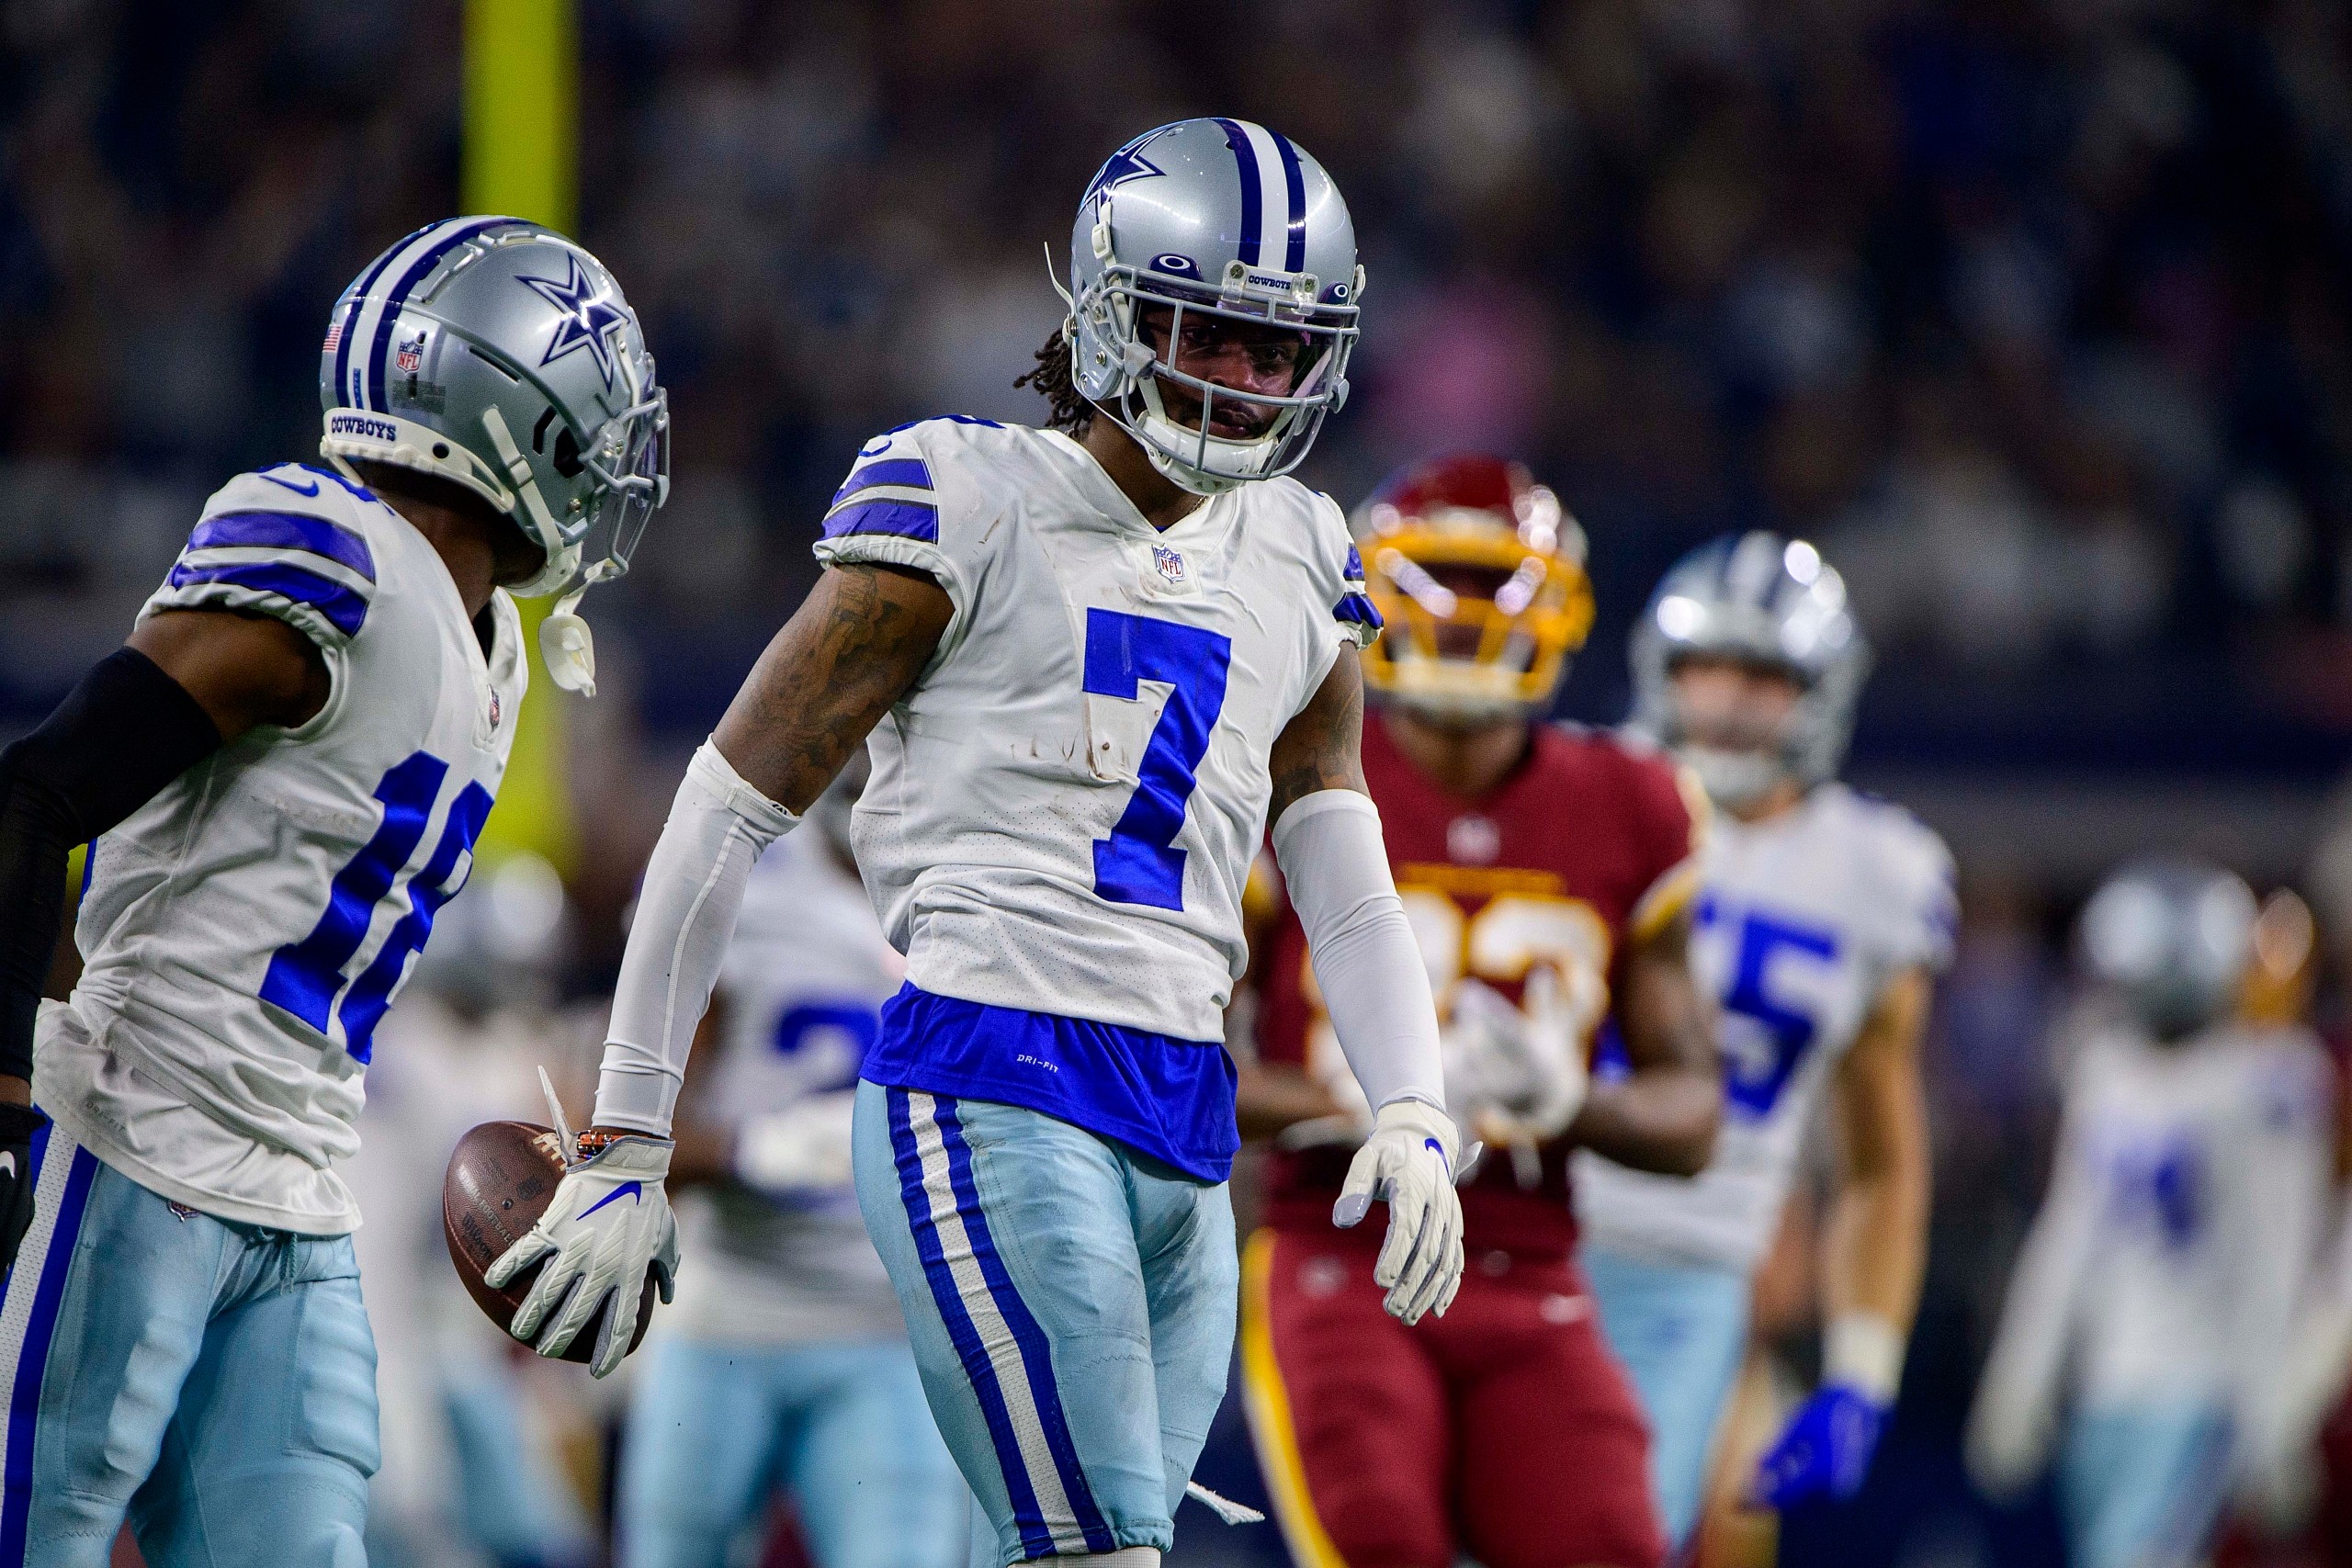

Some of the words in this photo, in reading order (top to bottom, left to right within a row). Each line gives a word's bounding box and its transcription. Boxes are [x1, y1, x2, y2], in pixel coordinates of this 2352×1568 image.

[1248, 275, 1292, 290] COWBOYS
[398, 352, 418, 369] NFL
[331, 415, 397, 442] COWBOYS
[1159, 558, 1182, 575] NFL
[1082, 606, 1232, 912] 7
[1016, 1054, 1059, 1074] DRI-FIT
[86, 1101, 126, 1132] DRI-FIT
[478, 1199, 517, 1247] FOOTBALL
